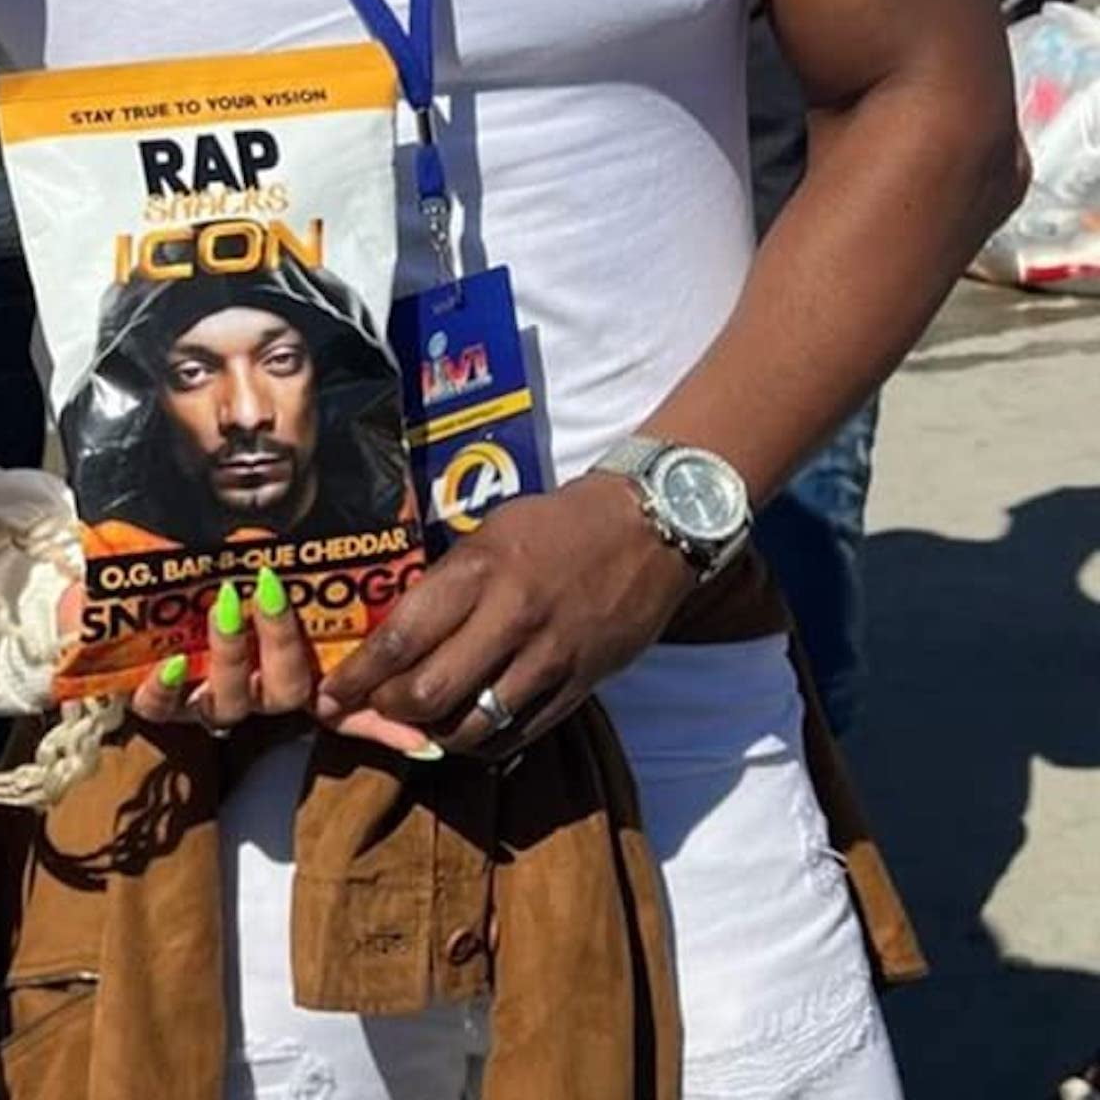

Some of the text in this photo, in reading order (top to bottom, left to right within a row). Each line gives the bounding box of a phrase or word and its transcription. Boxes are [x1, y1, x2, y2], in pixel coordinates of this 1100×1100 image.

[69, 87, 327, 124] STAY TRUE TO YOUR VISION
[137, 129, 280, 197] RAP
[113, 217, 325, 287] ICON
[100, 527, 409, 590] O.G. BAR-B-QUE CHEDDAR
